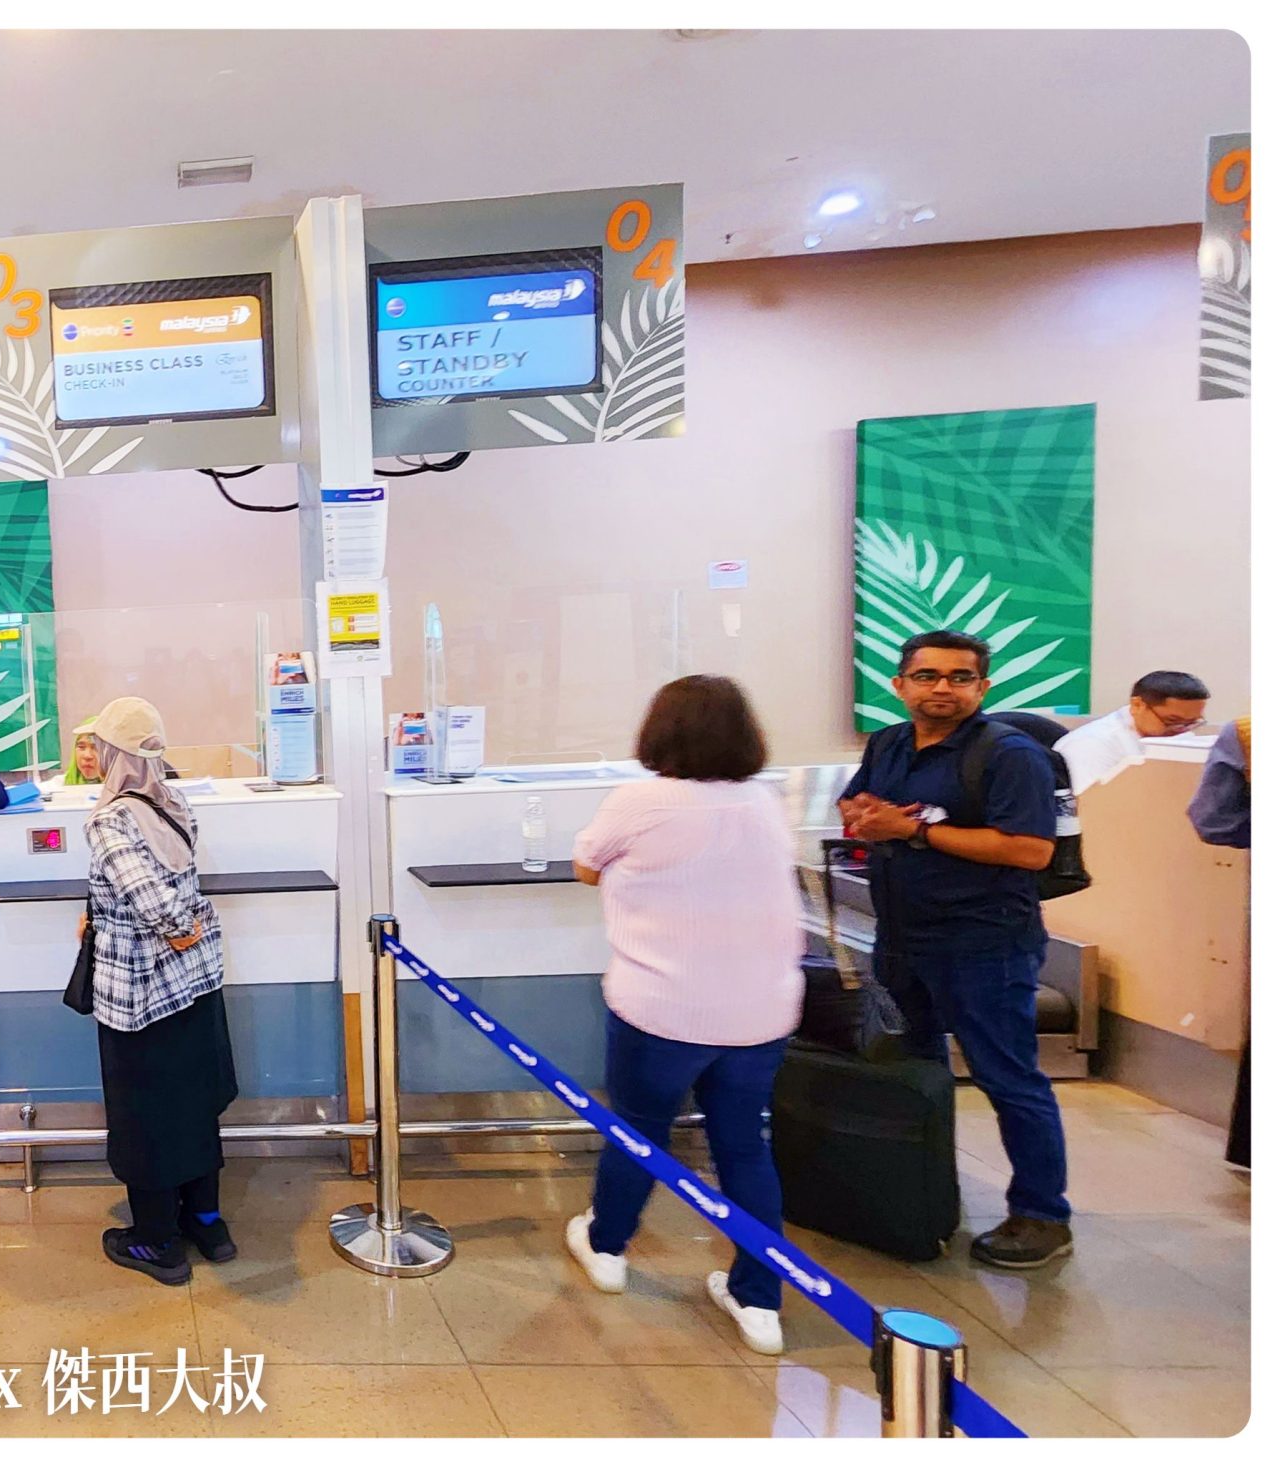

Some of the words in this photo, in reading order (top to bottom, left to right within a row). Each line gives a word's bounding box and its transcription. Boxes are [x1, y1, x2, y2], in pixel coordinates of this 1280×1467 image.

[606, 199, 677, 289] 04
[398, 329, 481, 351] STAFF
[64, 359, 144, 377] BUSINESS
[150, 355, 204, 371] CLASS
[398, 351, 528, 377] STANDBY
[64, 377, 126, 392] CHECK-IN
[398, 376, 496, 393] COUNTER
